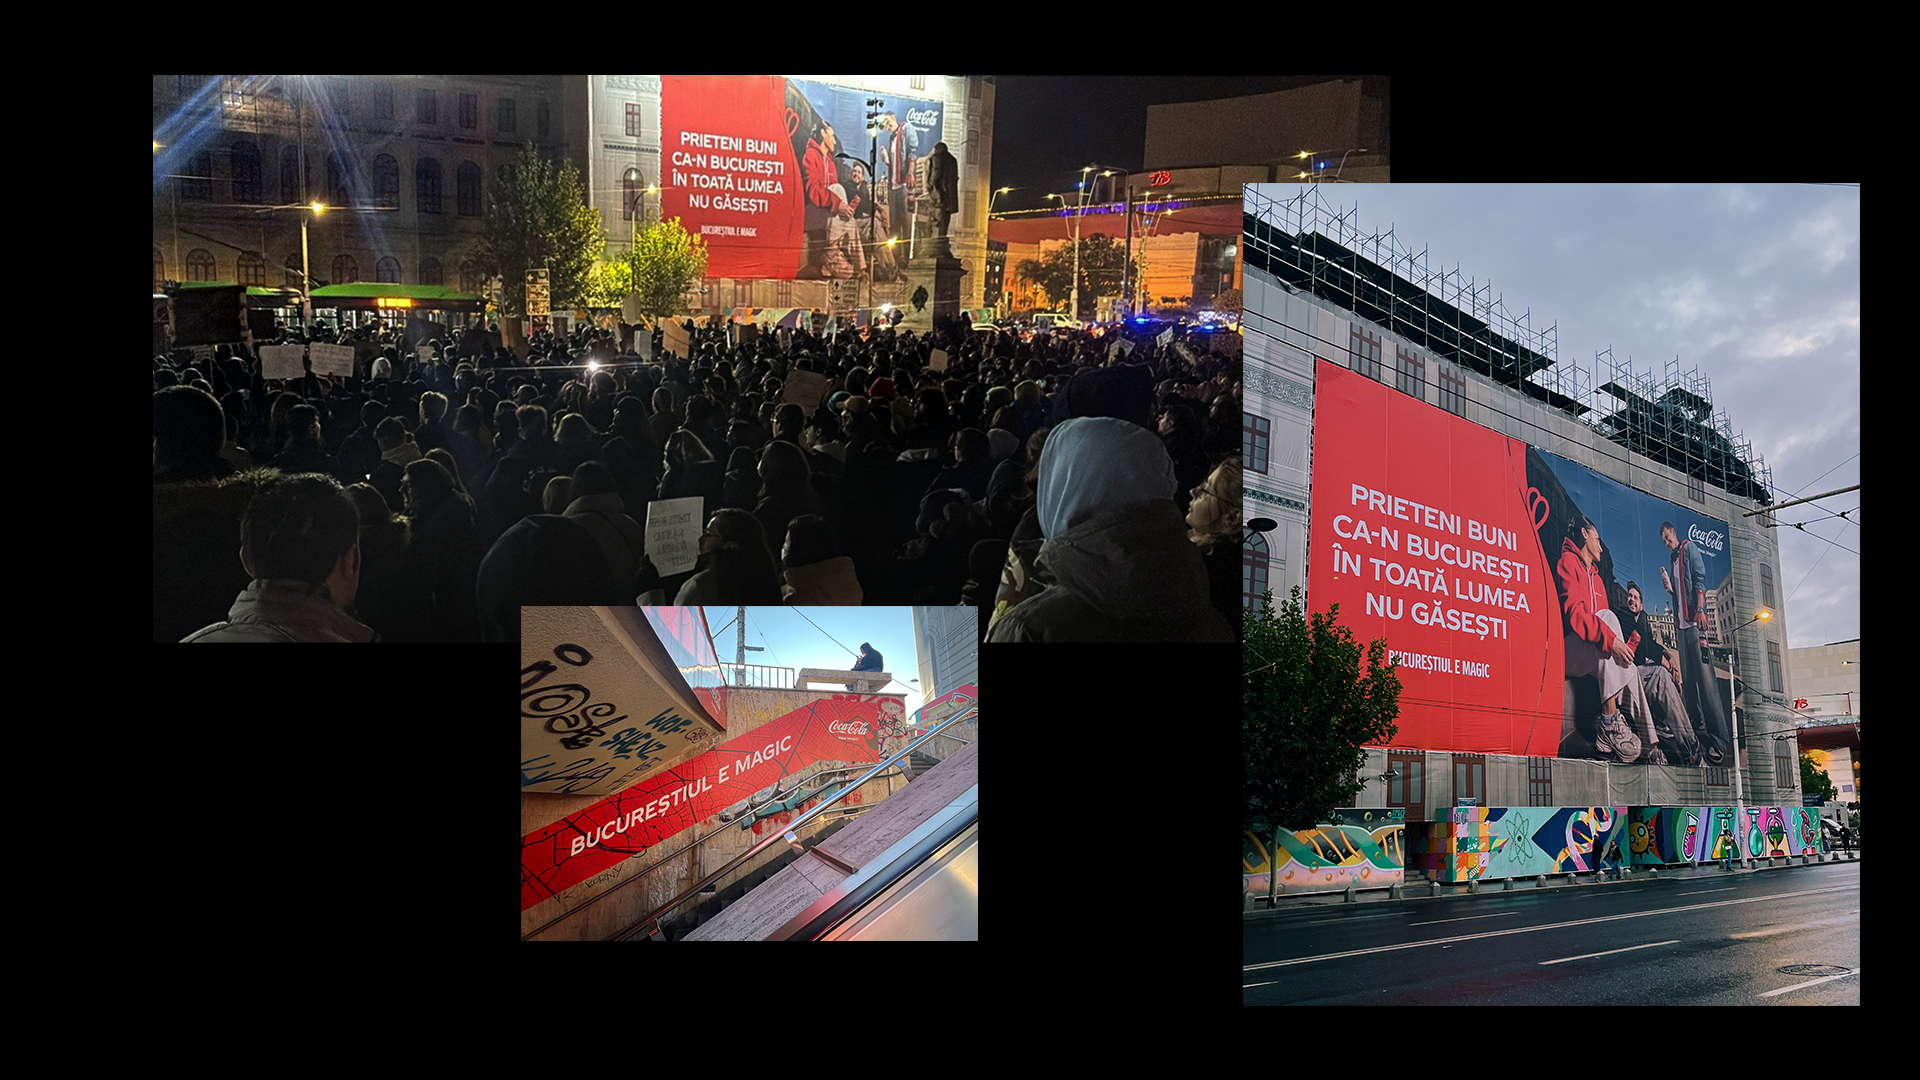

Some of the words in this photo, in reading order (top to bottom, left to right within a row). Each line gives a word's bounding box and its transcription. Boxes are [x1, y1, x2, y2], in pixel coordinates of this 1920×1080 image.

[680, 131, 742, 151] PRIETENI
[745, 138, 777, 155] BUNI
[672, 151, 706, 168] CA-N
[710, 155, 784, 177] BUCUREȘTI
[672, 168, 687, 187] ÎN
[690, 173, 734, 191] TOATĂ
[737, 177, 784, 194] LUMEA
[689, 194, 709, 209] NU
[713, 193, 768, 215] GĂSEȘTI
[736, 226, 740, 236] E
[740, 227, 757, 237] MAGIC
[1351, 483, 1461, 536] PRIETENI
[1468, 519, 1517, 552] BUNI
[1333, 514, 1399, 551] CA-N
[1407, 532, 1529, 584] BUCUREȘTI
[1332, 542, 1361, 577] ÎN
[1369, 557, 1449, 596] TOATĂ
[1455, 578, 1531, 614] LUMEA
[1366, 592, 1404, 620] NU
[1411, 599, 1507, 641] GĂSEȘTI
[1455, 659, 1461, 675] E
[1462, 660, 1490, 678] MAGIC
[570, 776, 713, 857] BUCUREȘTIUL
[718, 764, 730, 785] E
[735, 735, 792, 776] MAGIC
